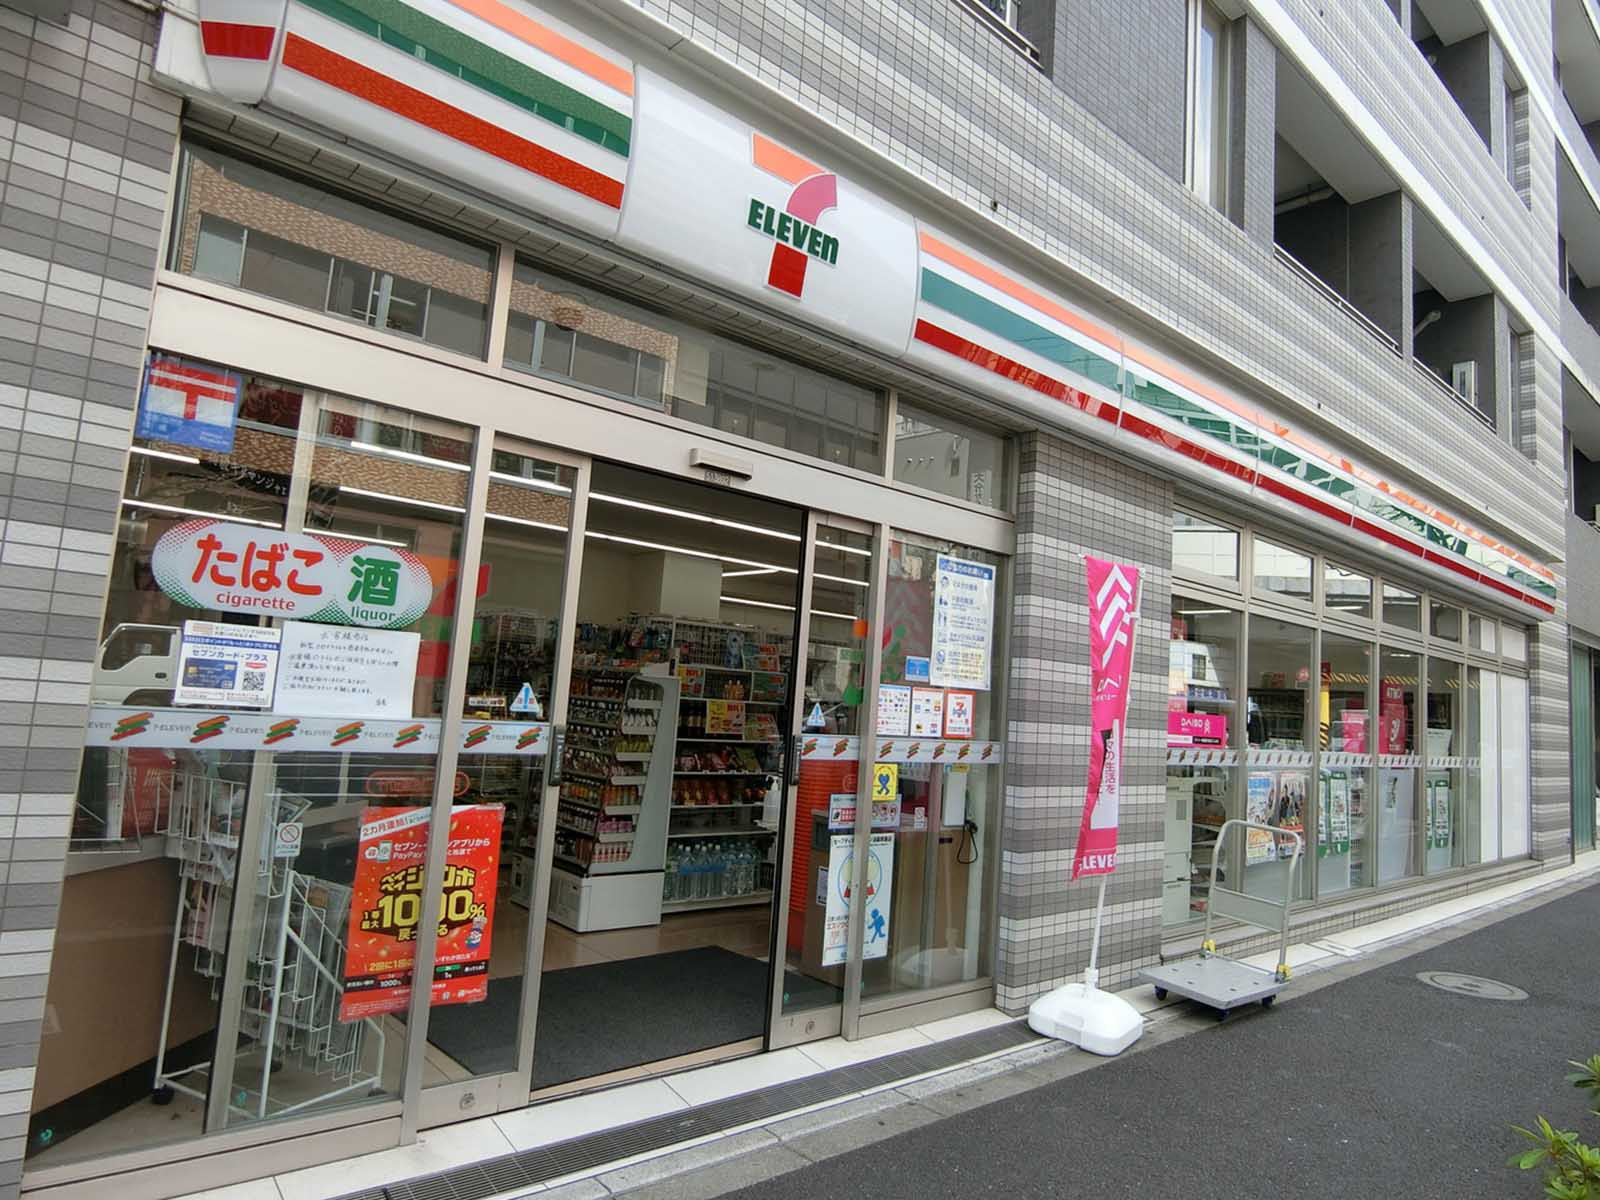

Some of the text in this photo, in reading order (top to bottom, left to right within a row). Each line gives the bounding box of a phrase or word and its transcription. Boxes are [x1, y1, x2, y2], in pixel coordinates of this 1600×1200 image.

[192, 534, 401, 607] たばこ 酒
[216, 592, 395, 623] cigarette liquor
